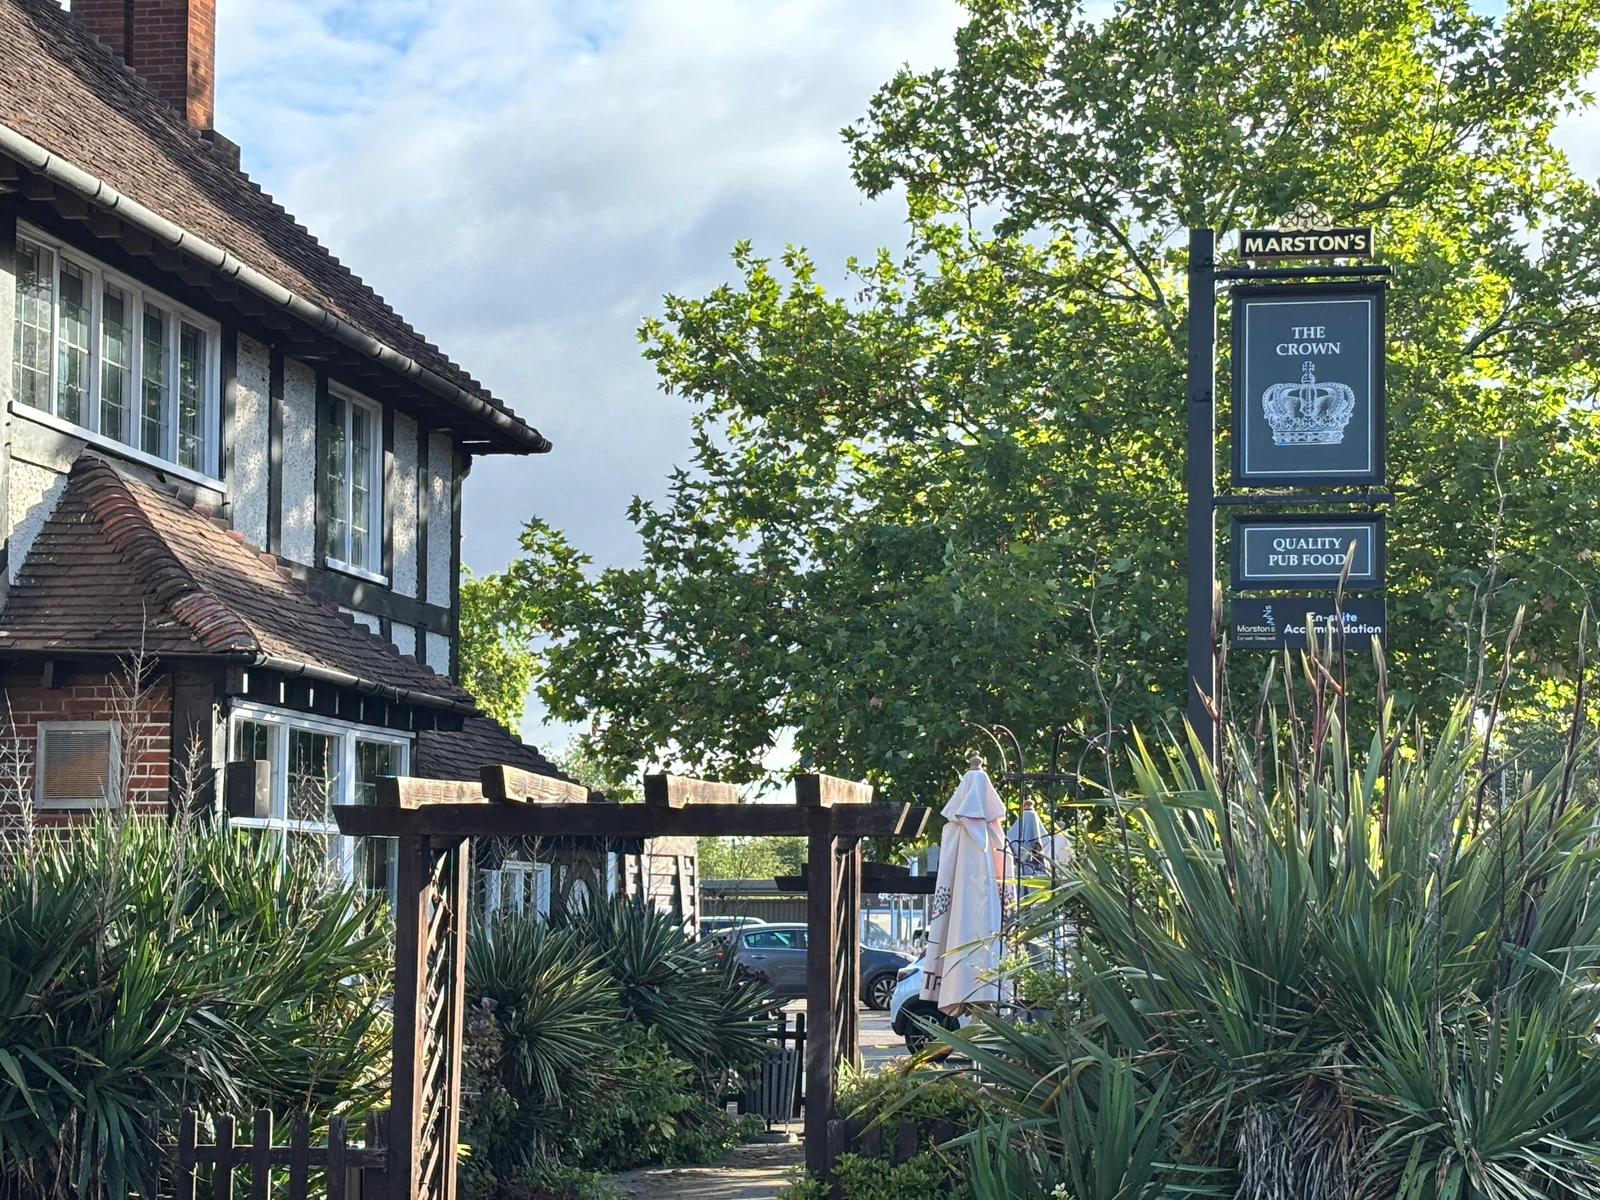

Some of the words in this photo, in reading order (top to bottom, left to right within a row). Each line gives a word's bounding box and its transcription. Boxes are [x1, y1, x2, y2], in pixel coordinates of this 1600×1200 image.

[1244, 234, 1366, 253] MARSTON'S
[1291, 326, 1326, 339] THE
[1276, 342, 1341, 356] CROWN
[1273, 537, 1343, 552] QUALITY
[1268, 554, 1299, 566] PUB
[1301, 553, 1347, 566] FOOD
[1283, 623, 1382, 634] Accmmdation
